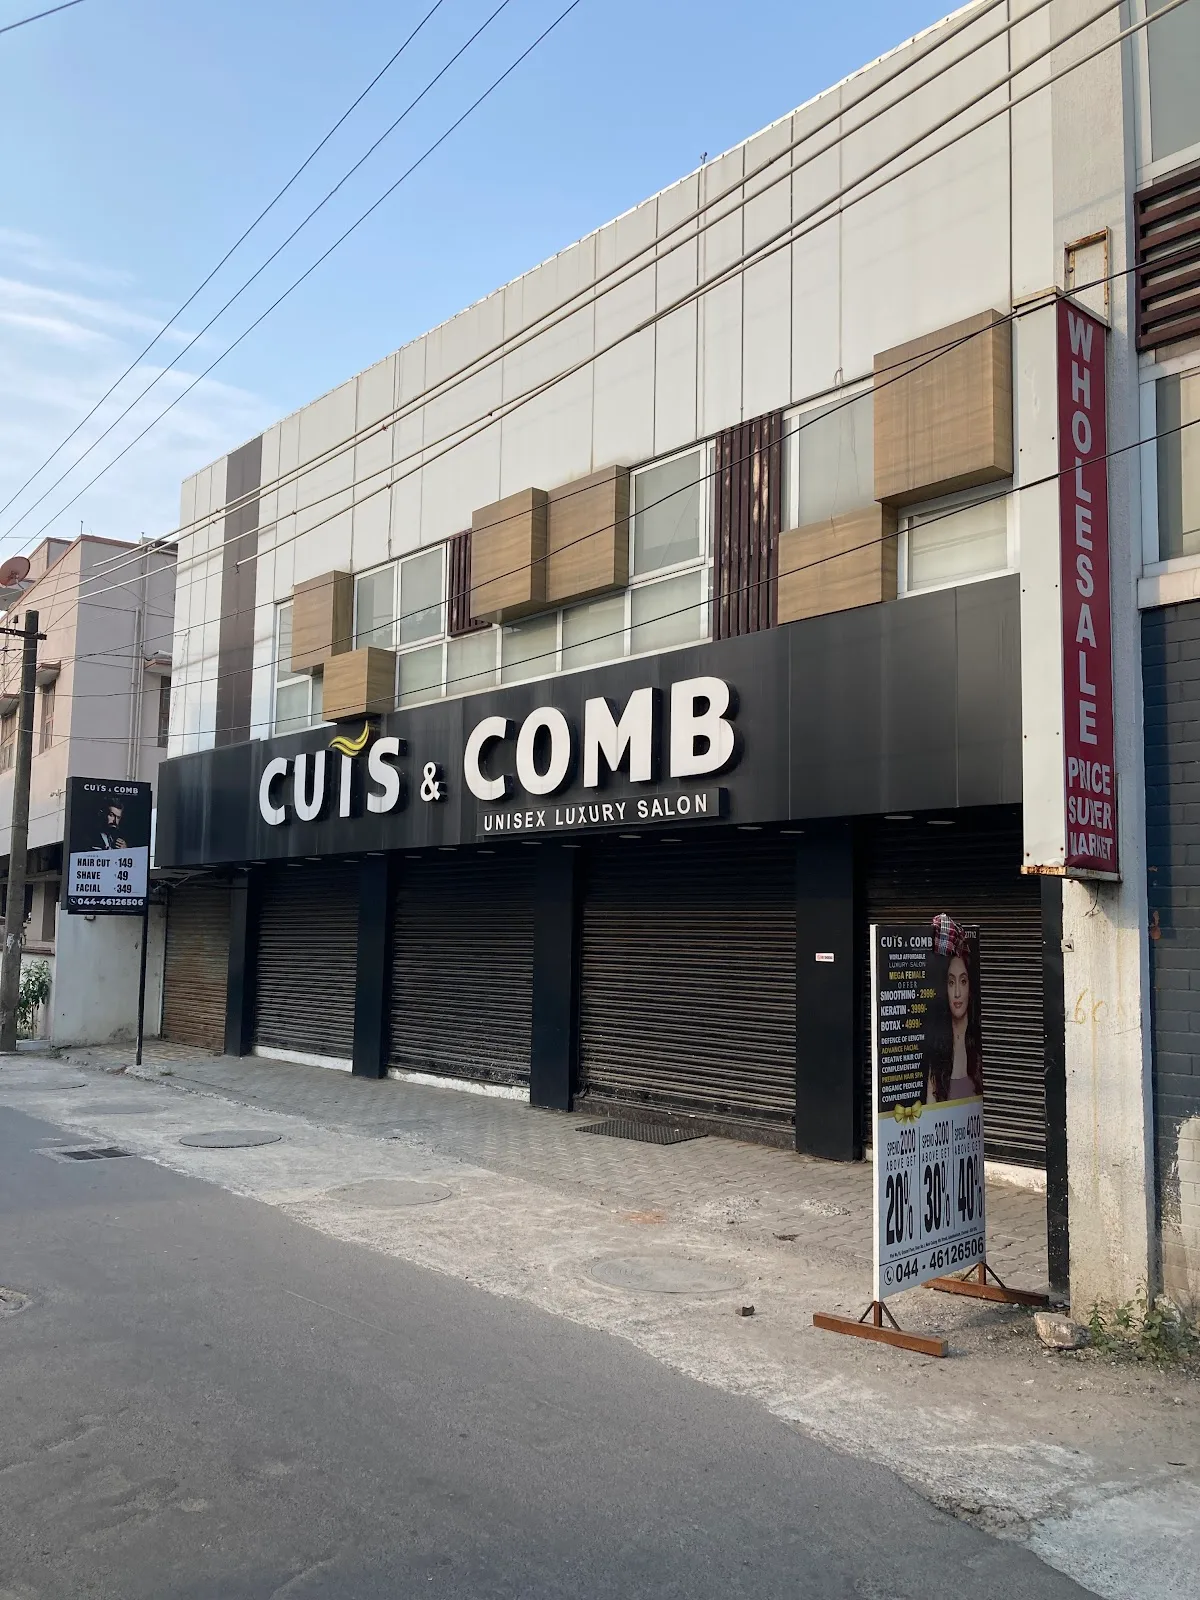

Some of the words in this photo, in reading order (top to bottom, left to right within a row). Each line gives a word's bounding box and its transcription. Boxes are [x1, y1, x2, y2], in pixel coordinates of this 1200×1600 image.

[1067, 310, 1097, 745] WHOLESALE
[259, 720, 400, 826] CUTS
[420, 761, 442, 802] &
[464, 676, 735, 801] COMB
[1067, 756, 1111, 796] PRICE
[84, 784, 106, 792] CUTS
[114, 786, 138, 794] COMB
[484, 810, 546, 831] UNISEX
[555, 802, 626, 826] LUXURY
[637, 793, 707, 818] SALON
[77, 858, 95, 867] HAIR
[96, 859, 110, 867] CUT
[76, 871, 101, 880] SHAVE
[75, 883, 101, 892] FACIAL
[77, 897, 144, 906] 044-46126506
[880, 934, 903, 947] CUTS
[910, 936, 932, 947] COMB
[889, 971, 905, 980] MEGA
[905, 971, 925, 979] FEMALE
[880, 990, 916, 1001] SMOOTHING
[880, 1005, 906, 1016] KERATIN
[880, 1020, 901, 1032] BOTAX
[881, 1036, 901, 1044] DEFENCE
[908, 1034, 925, 1042] LENGTH
[882, 1046, 903, 1054] ADVANCE
[904, 1044, 919, 1052] FACIAL
[882, 1055, 902, 1064] CREATIVE
[882, 1062, 920, 1074] COMPLEMENTARY
[882, 1084, 902, 1093] ORGANIC
[903, 1081, 924, 1090] PEDICURE
[882, 1091, 921, 1103] COMPLEMENTARY
[954, 1127, 966, 1141] SPEND
[967, 1114, 980, 1140] 4000
[922, 1134, 934, 1149] SPEND
[935, 1121, 949, 1147] 3000
[887, 1141, 900, 1156] SPEND
[900, 1128, 916, 1155] 2000
[954, 1142, 970, 1155] ABOVE
[972, 1140, 981, 1151] GET
[922, 1150, 938, 1163] ABOVE
[941, 1147, 950, 1159] GET
[886, 1158, 904, 1172] ABOVE
[907, 1155, 916, 1167] GET
[958, 1154, 983, 1222] 40%
[924, 1160, 950, 1233] 30%
[886, 1169, 913, 1246] 20%
[896, 1258, 918, 1282] 044
[930, 1236, 984, 1270] 46126506
